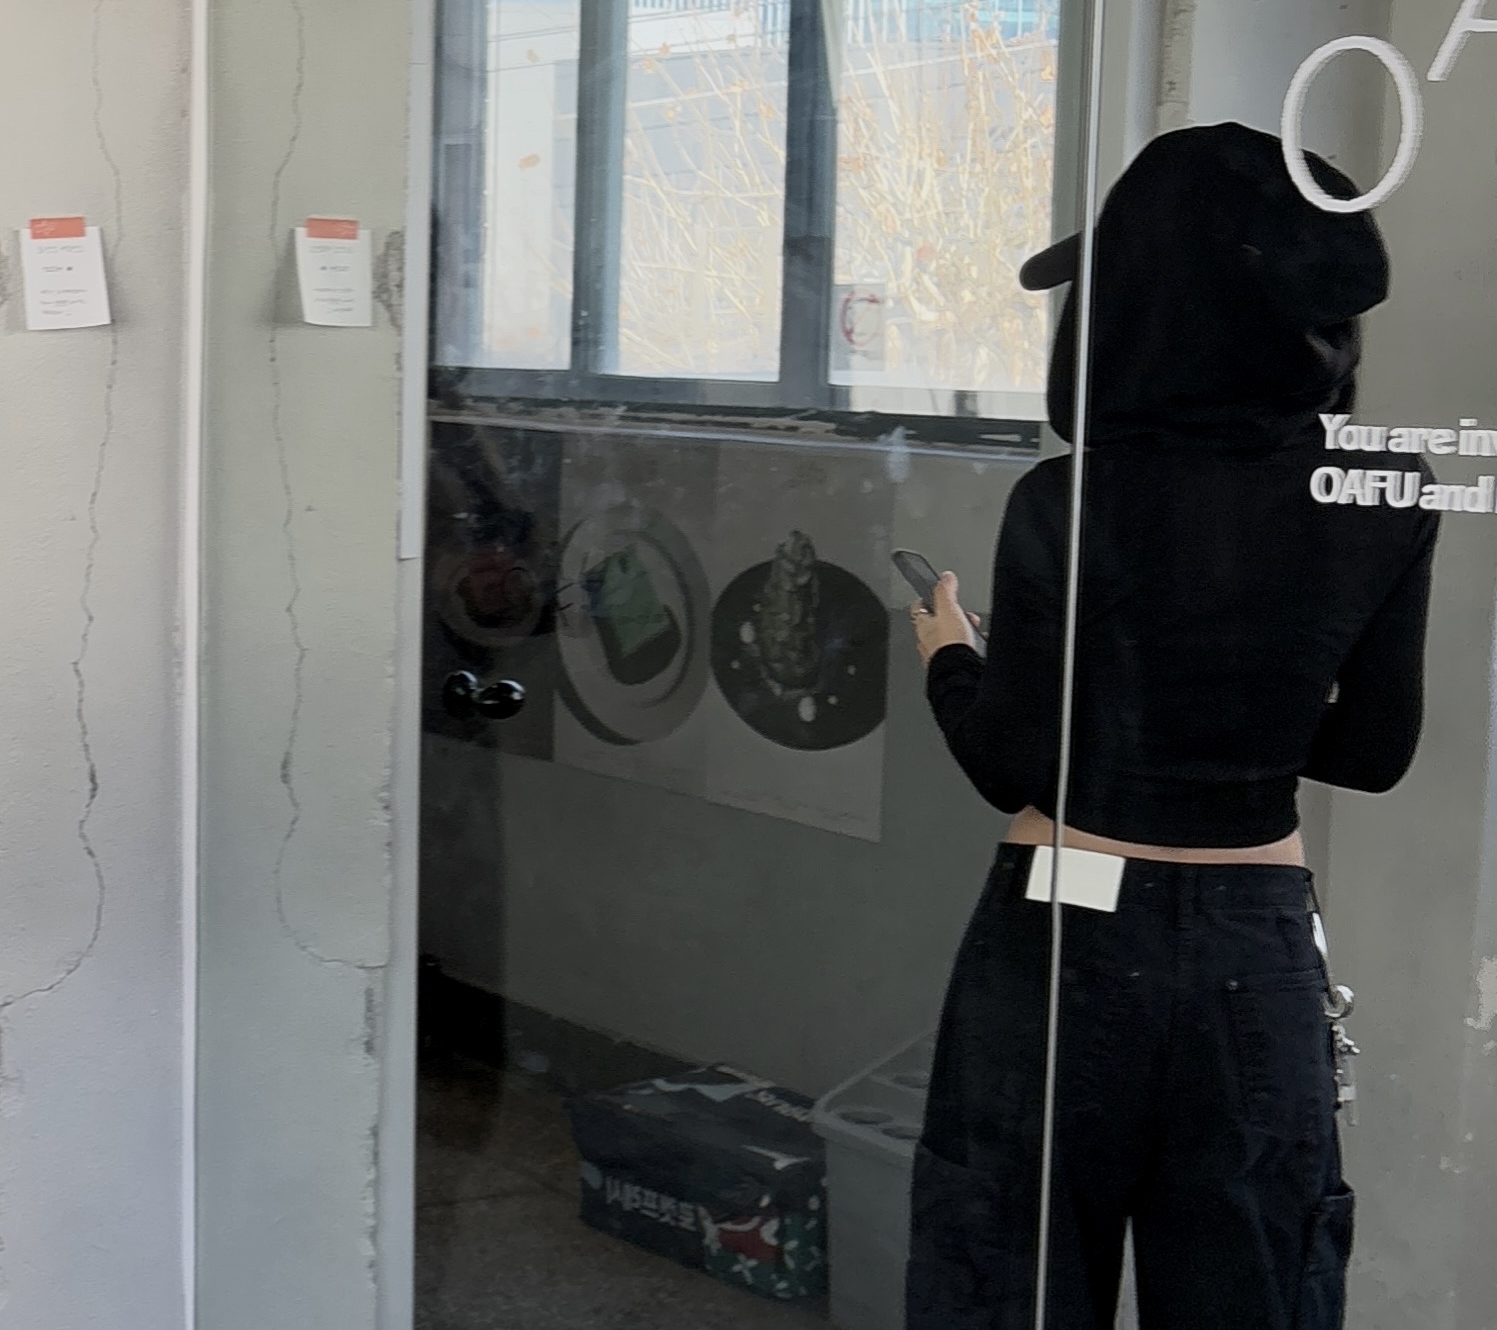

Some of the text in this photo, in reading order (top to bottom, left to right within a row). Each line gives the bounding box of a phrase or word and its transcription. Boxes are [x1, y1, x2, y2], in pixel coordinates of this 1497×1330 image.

[1317, 413, 1387, 452] You
[1387, 427, 1458, 455] are
[1310, 466, 1495, 513] OAFU and
